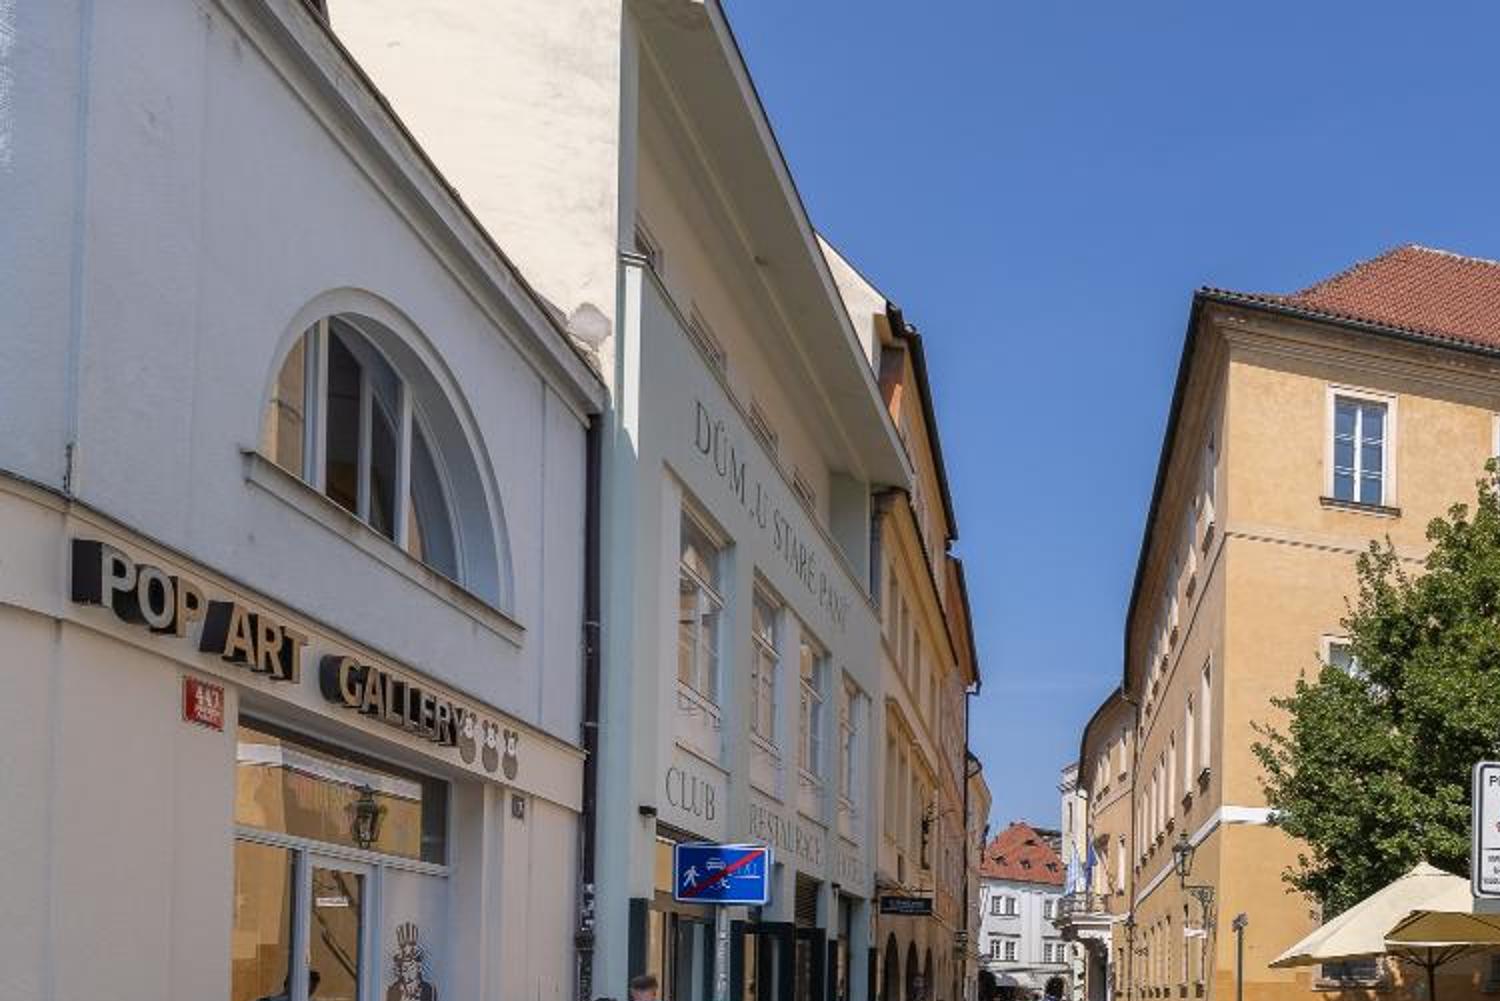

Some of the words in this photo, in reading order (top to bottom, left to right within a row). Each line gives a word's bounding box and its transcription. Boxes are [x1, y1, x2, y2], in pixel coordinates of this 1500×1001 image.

[90, 541, 209, 638] POP
[214, 600, 308, 684] ART
[331, 655, 467, 747] GALLERY
[665, 767, 715, 820] CLUB
